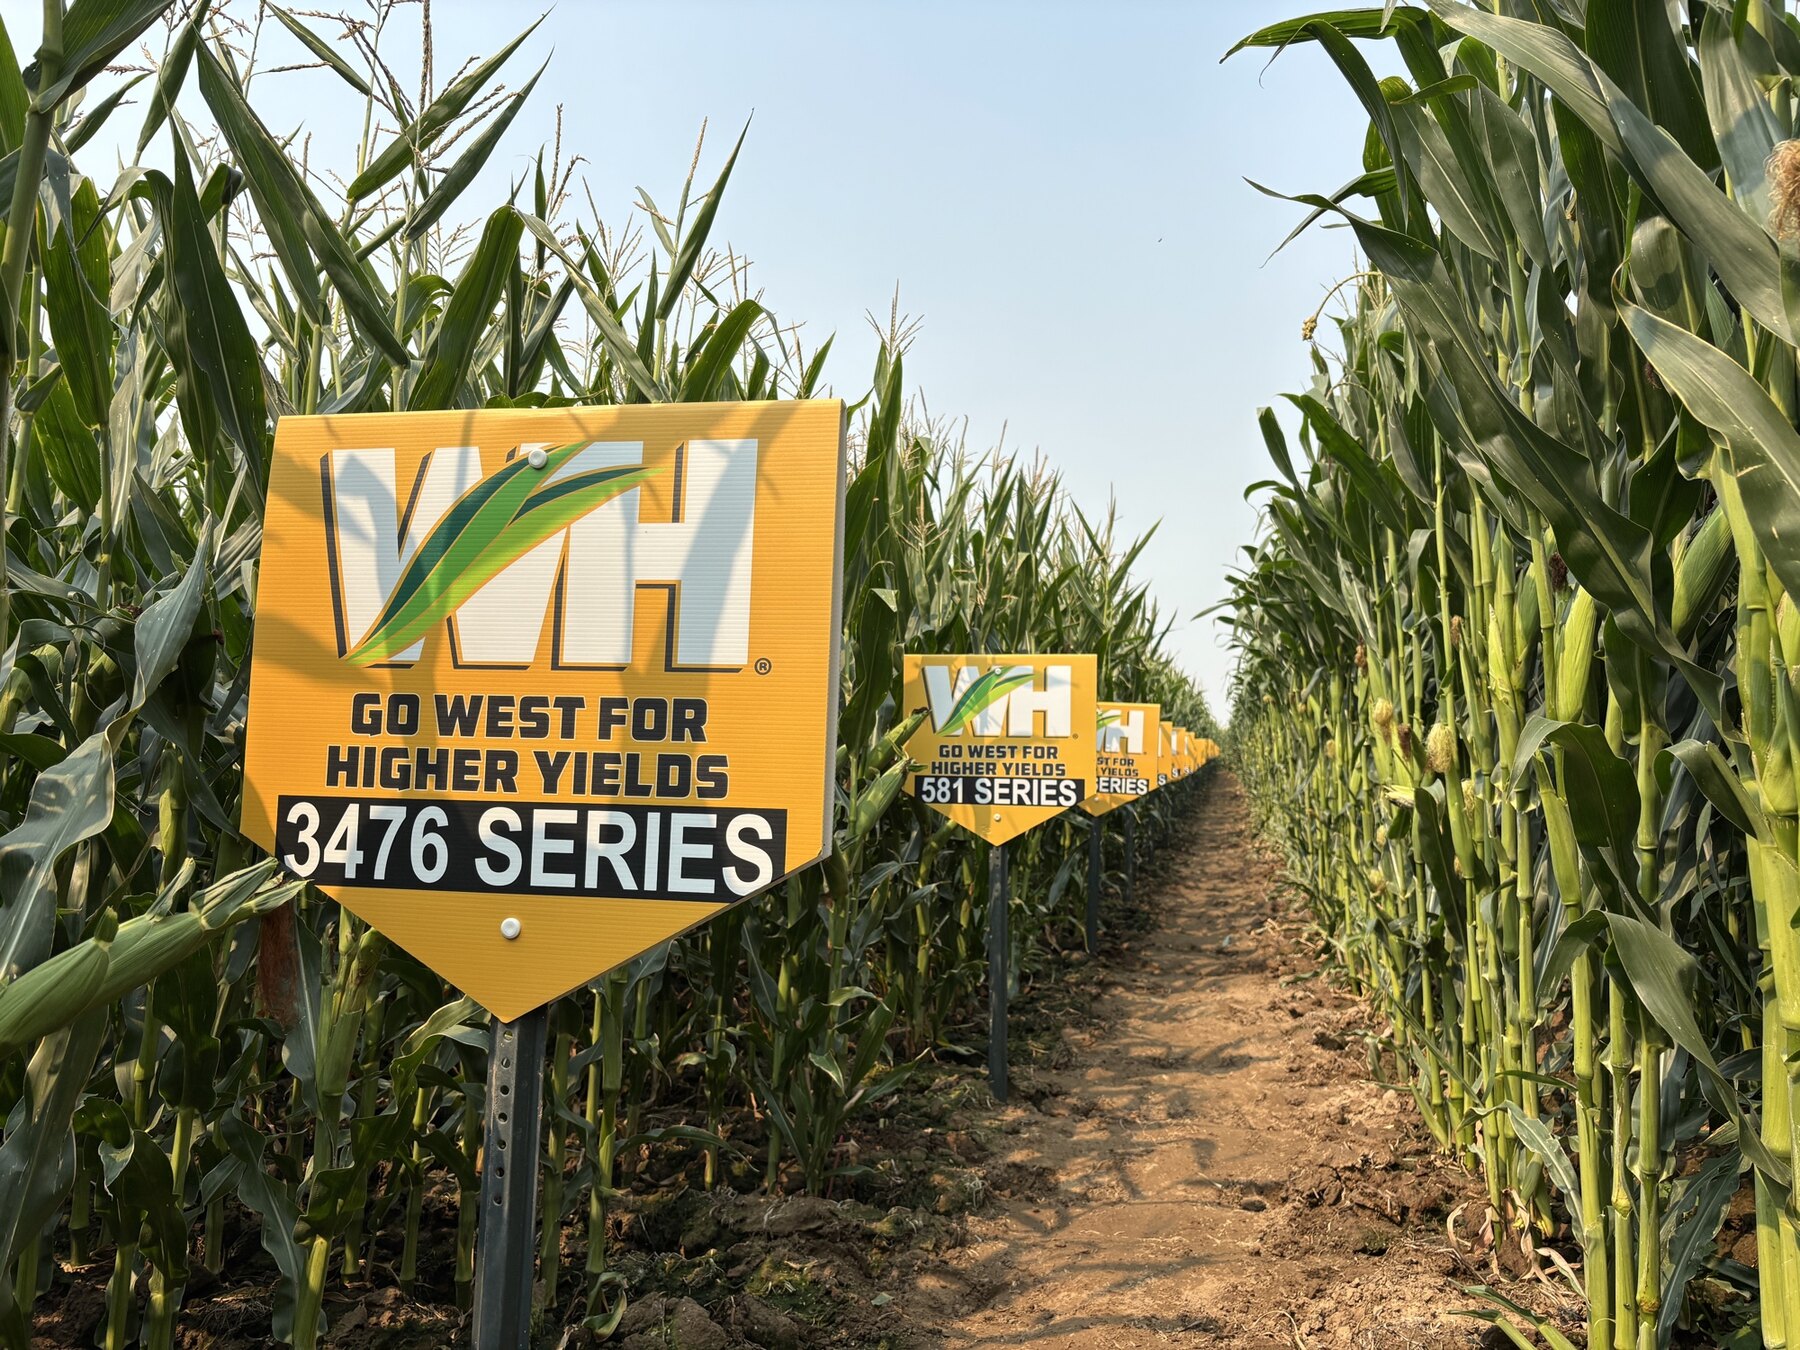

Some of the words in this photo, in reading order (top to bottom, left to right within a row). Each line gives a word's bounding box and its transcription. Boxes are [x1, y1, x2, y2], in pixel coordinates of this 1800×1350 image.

[350, 692, 421, 738] GO
[434, 694, 586, 740] WEST
[597, 697, 709, 743] FOR
[939, 744, 963, 758] GO
[968, 745, 1018, 759] WEST
[1023, 746, 1058, 760] FOR
[325, 745, 519, 792] HIGHER
[533, 750, 730, 799] YIELDS
[931, 761, 997, 776] HIGHER
[1003, 763, 1066, 777] YIELDS
[1101, 767, 1139, 777] YIELDS
[1112, 758, 1135, 767] FOR
[921, 777, 964, 804] 581
[974, 778, 1078, 807] SERIES
[1097, 777, 1149, 796] ERIES
[283, 801, 449, 884] 3476
[475, 806, 775, 896] SERIES
